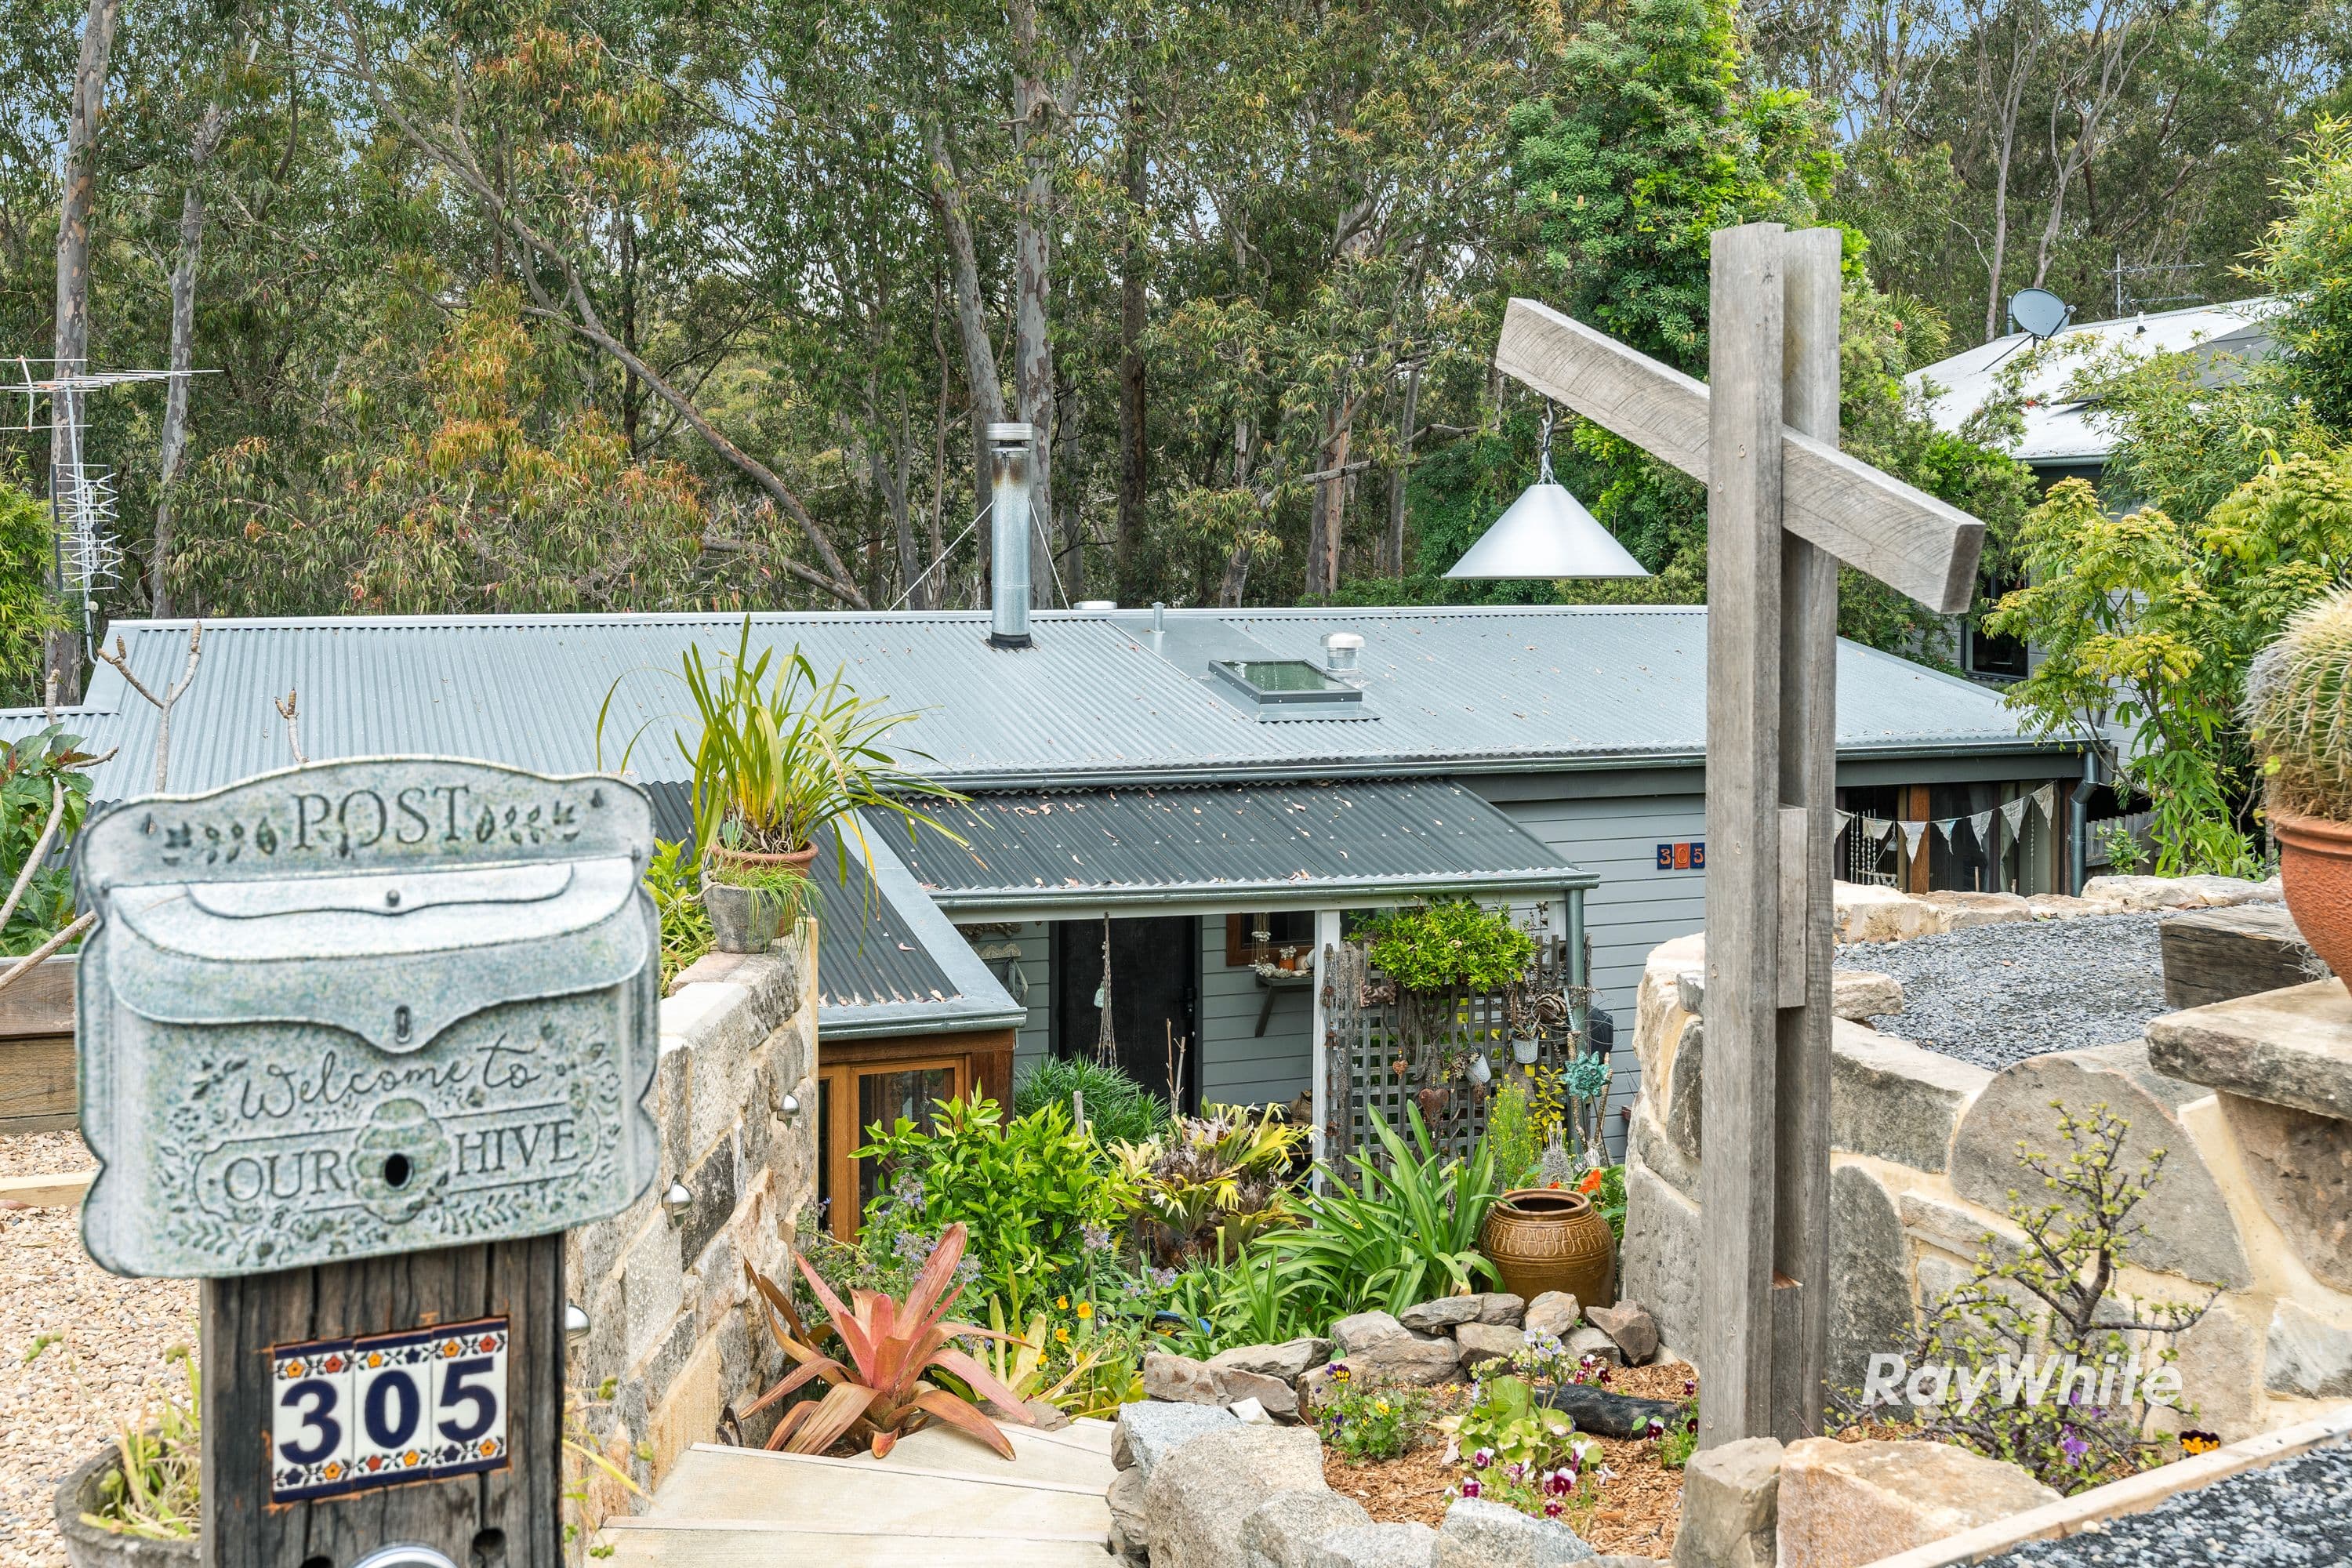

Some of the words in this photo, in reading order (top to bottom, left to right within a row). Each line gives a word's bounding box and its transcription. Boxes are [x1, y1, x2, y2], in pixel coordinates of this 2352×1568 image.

[291, 785, 470, 851] POST
[1660, 848, 1704, 865] 305
[241, 1051, 472, 1120] Welcome
[477, 1032, 543, 1090] to
[224, 1149, 345, 1203] OUR
[455, 1119, 580, 1176] HIVE
[279, 1357, 497, 1465] 305
